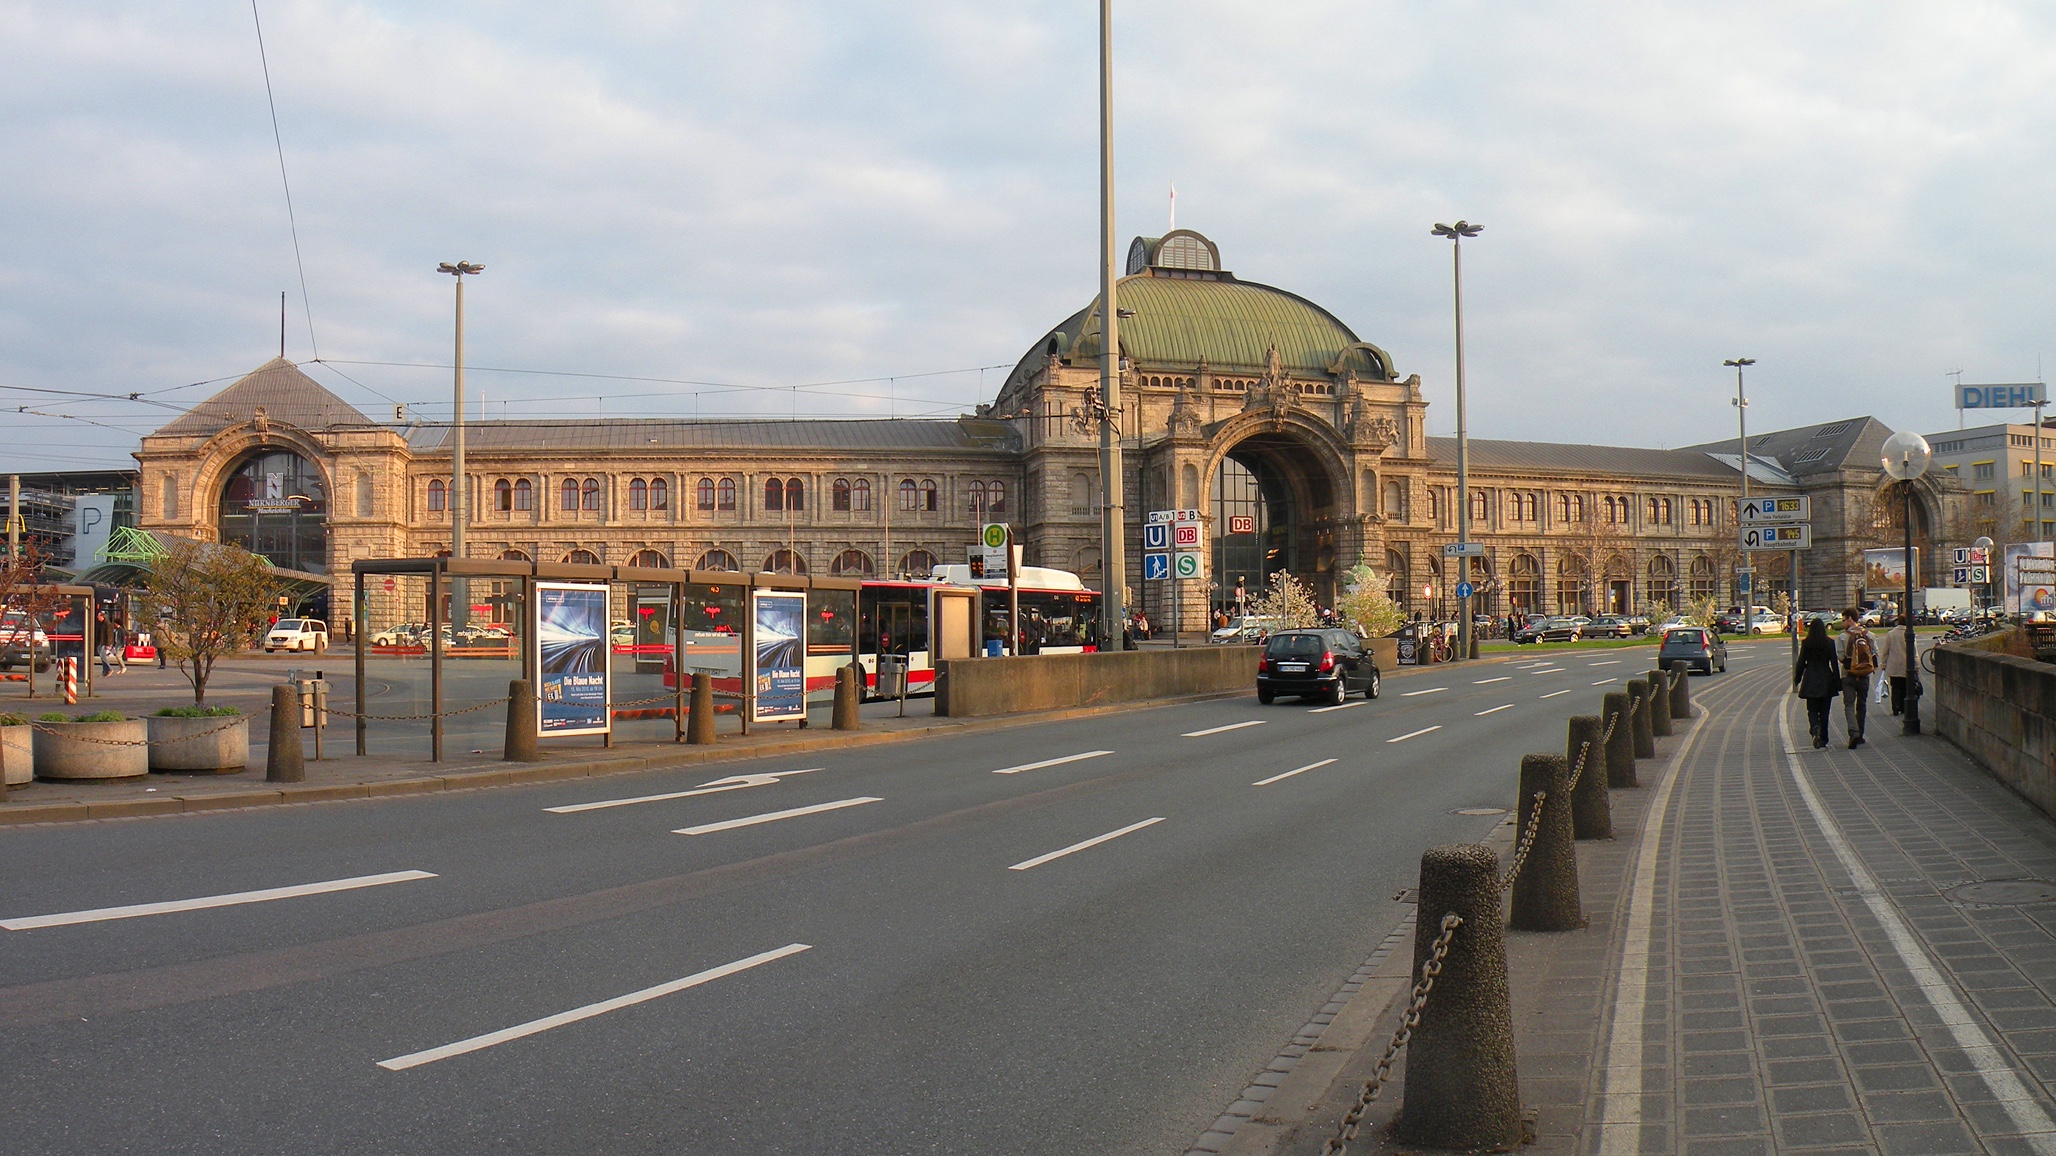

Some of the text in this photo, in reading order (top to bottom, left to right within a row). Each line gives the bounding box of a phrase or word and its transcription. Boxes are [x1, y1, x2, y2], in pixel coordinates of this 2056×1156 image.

[396, 406, 403, 419] E
[1765, 501, 1799, 511] P 1633
[83, 507, 102, 534] P
[1189, 511, 1196, 520] B
[1235, 519, 1251, 530] DB
[990, 529, 1000, 543] H
[1149, 528, 1163, 546] U
[1179, 530, 1195, 541] DB
[1766, 530, 1773, 539] P
[1955, 550, 1965, 563] U
[1180, 557, 1193, 574] S
[1974, 569, 1984, 580] S
[563, 675, 603, 686] Die Blaue Nacht
